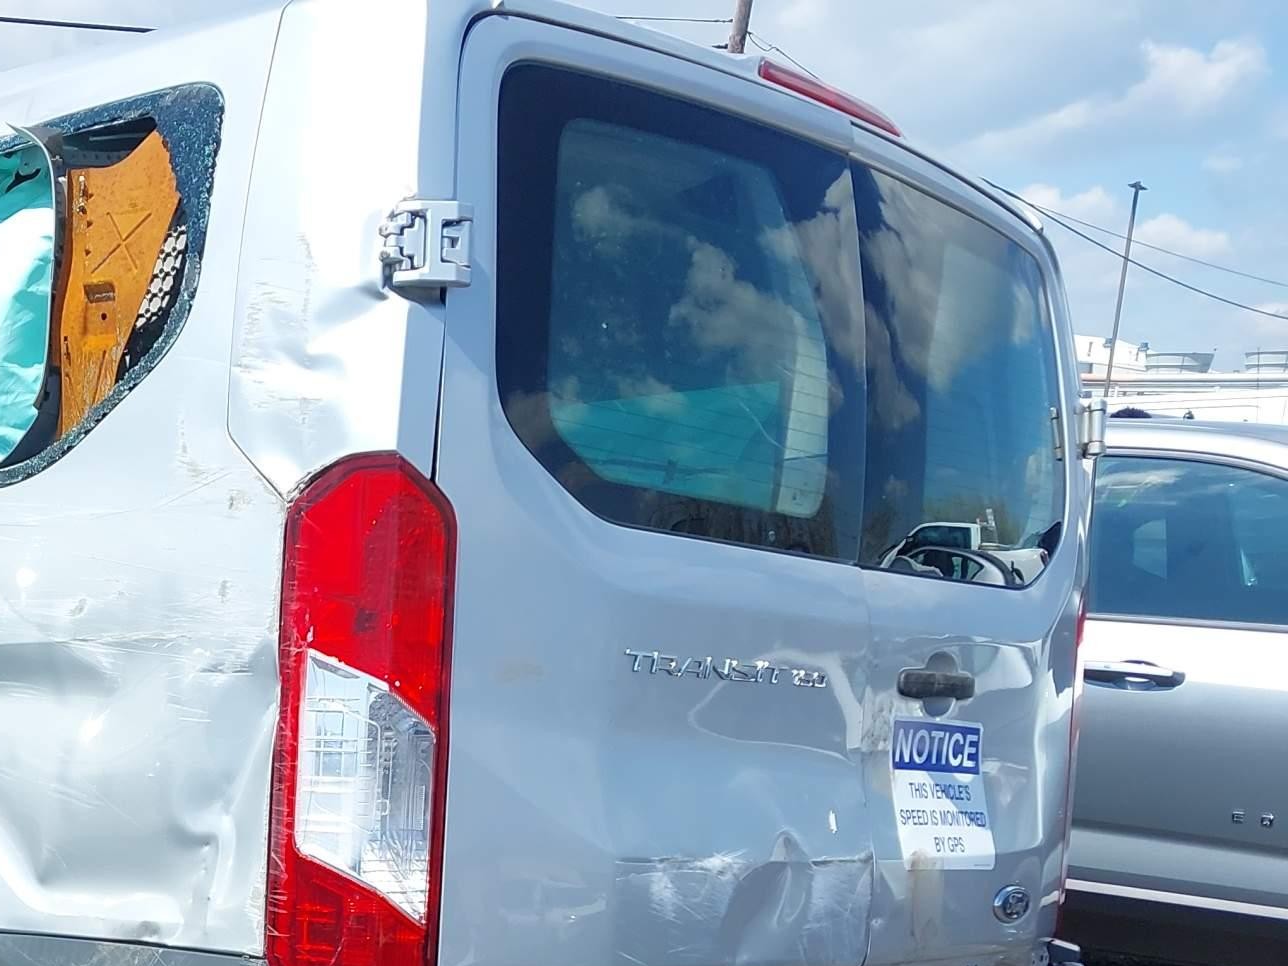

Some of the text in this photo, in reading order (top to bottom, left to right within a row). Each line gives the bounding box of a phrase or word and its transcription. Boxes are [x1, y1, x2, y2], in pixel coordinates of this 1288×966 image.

[624, 648, 790, 684] TRANSIT
[895, 728, 979, 768] NOTICE
[909, 782, 972, 801] THIS VEHICLE'S
[900, 810, 987, 828] SPEED IS MONITORED
[934, 837, 966, 853] BY GPS
